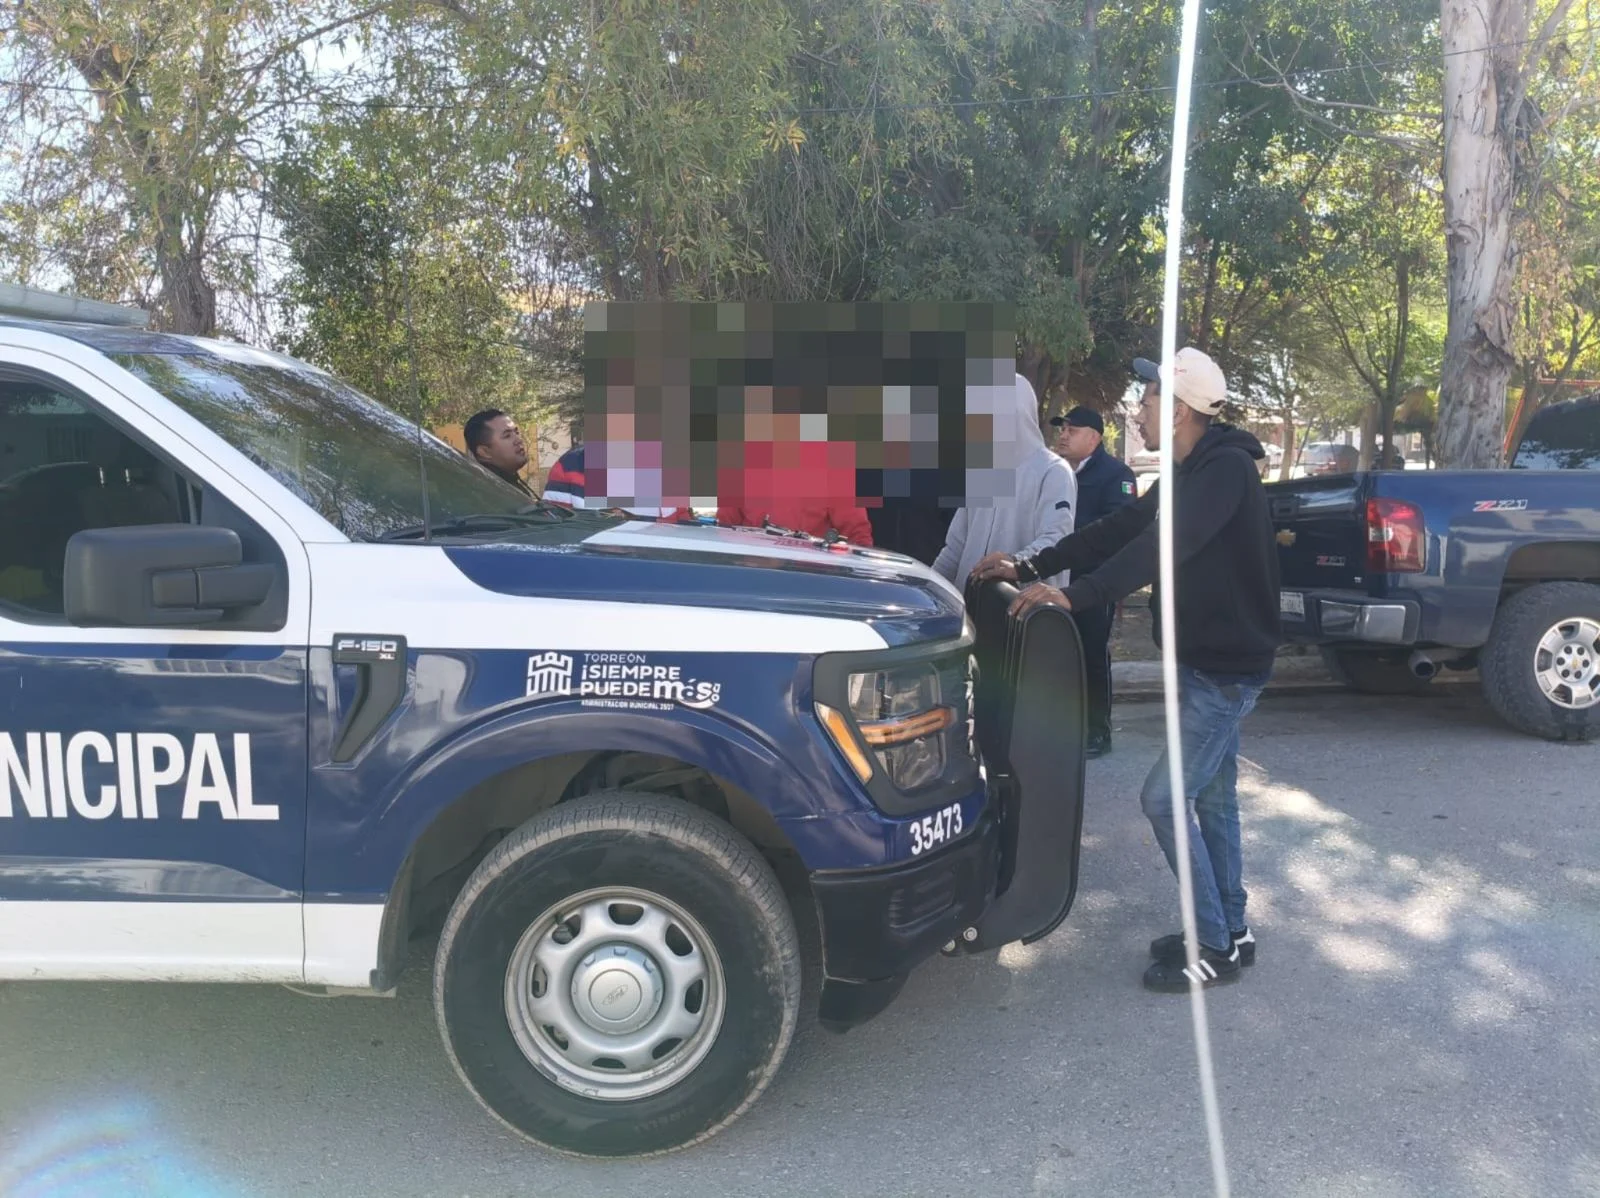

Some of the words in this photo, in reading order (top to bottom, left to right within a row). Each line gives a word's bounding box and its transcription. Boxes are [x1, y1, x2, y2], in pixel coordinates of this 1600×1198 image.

[338, 640, 397, 652] F-150
[582, 665, 680, 680] ¡SIEMPRE
[0, 731, 280, 820] NICIPAL
[909, 803, 962, 855] 35473
